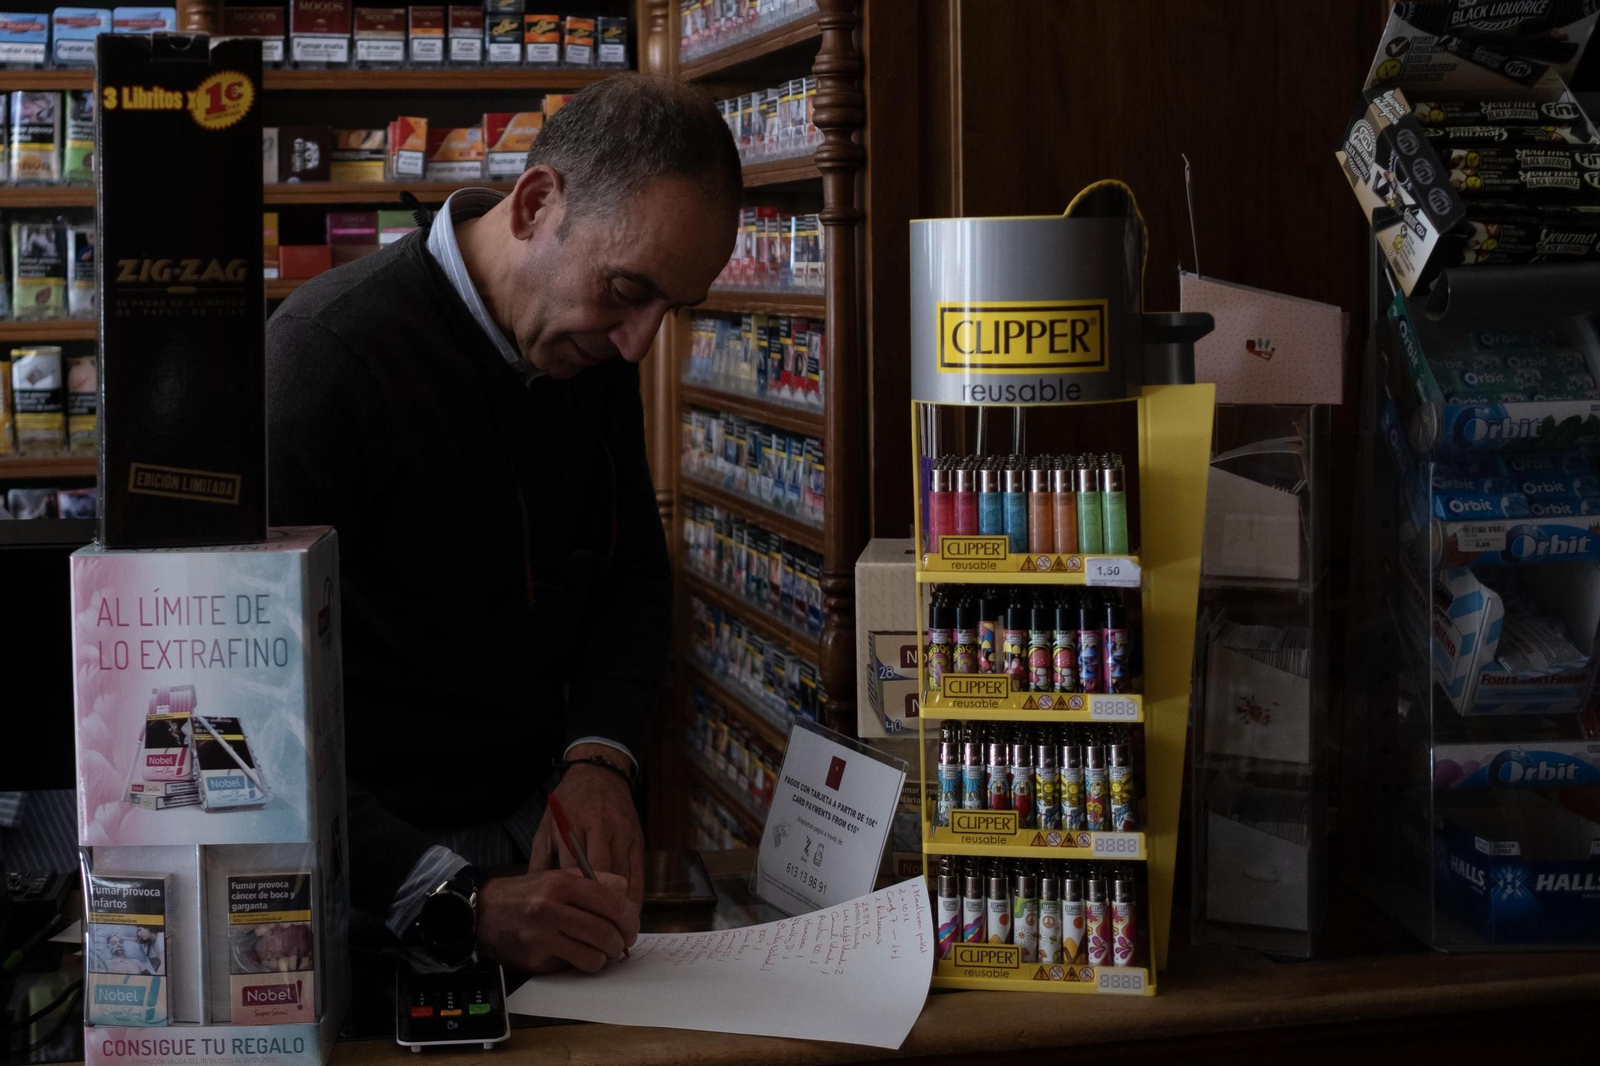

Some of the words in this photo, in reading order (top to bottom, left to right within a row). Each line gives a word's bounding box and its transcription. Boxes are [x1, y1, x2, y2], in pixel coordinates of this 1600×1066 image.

[1452, 6, 1487, 24] BLACK
[1490, 0, 1547, 22] LIQUORICE
[103, 85, 118, 110] 3
[121, 85, 184, 110] Libritos
[116, 258, 247, 283] ZIG-ZAG
[952, 318, 1091, 354] CLIPPER
[1399, 318, 1420, 370] Orbit
[1464, 369, 1506, 386] Orbit
[962, 378, 1082, 402] reusable
[1463, 417, 1543, 442] Orbit
[138, 470, 180, 491] EDICIÓN
[182, 476, 234, 496] LIMITADA
[1522, 480, 1565, 494] Orbit
[1448, 498, 1494, 514] Orbit
[1530, 502, 1574, 516] Orbit
[947, 542, 1002, 556] CLIPPER
[1511, 532, 1592, 558] Orbit
[952, 560, 997, 570] reusable
[1096, 566, 1120, 577] 1,50
[97, 597, 129, 627] AL
[140, 588, 226, 627] LÍMITE
[236, 594, 271, 625] DE
[99, 640, 129, 670] LO
[141, 638, 288, 670] EXTRAFINO
[879, 666, 895, 679] 28
[948, 680, 1002, 694] CLIPPER
[953, 698, 999, 708] reusable
[886, 720, 903, 732] 40
[149, 756, 174, 766] Nobel
[1498, 760, 1581, 783] Orbit
[210, 778, 241, 789] Nobel
[784, 775, 801, 789] PAGOS
[800, 783, 811, 795] CON
[810, 788, 832, 806] TARJETA
[838, 802, 857, 818] PARTIR
[857, 811, 865, 823] DE
[792, 794, 805, 806] CARD
[804, 800, 832, 821] PAYMENTS
[832, 814, 848, 827] FROM
[957, 816, 1011, 830] CLIPPER
[962, 835, 1007, 845] reusable
[903, 863, 940, 874] Noel
[1450, 855, 1485, 887] HALLS
[232, 882, 256, 890] Fumar
[258, 881, 289, 890] provoca
[786, 862, 799, 878] 613
[800, 870, 808, 884] 13
[808, 876, 818, 890] 98
[818, 881, 828, 895] 91
[123, 888, 161, 898] provoca
[232, 892, 257, 900] cáncer
[258, 891, 269, 899] de
[270, 890, 289, 899] boca
[290, 892, 296, 900] y
[92, 898, 128, 909] infartos
[232, 902, 268, 912] garganta
[960, 950, 1014, 965] CLIPPER
[964, 968, 1010, 978] reusable
[98, 988, 138, 1002] Nobel
[247, 988, 292, 1002] Nobel
[102, 1038, 196, 1056] CONSIGUE
[201, 1038, 225, 1055] TU
[232, 1037, 304, 1054] REGALO
